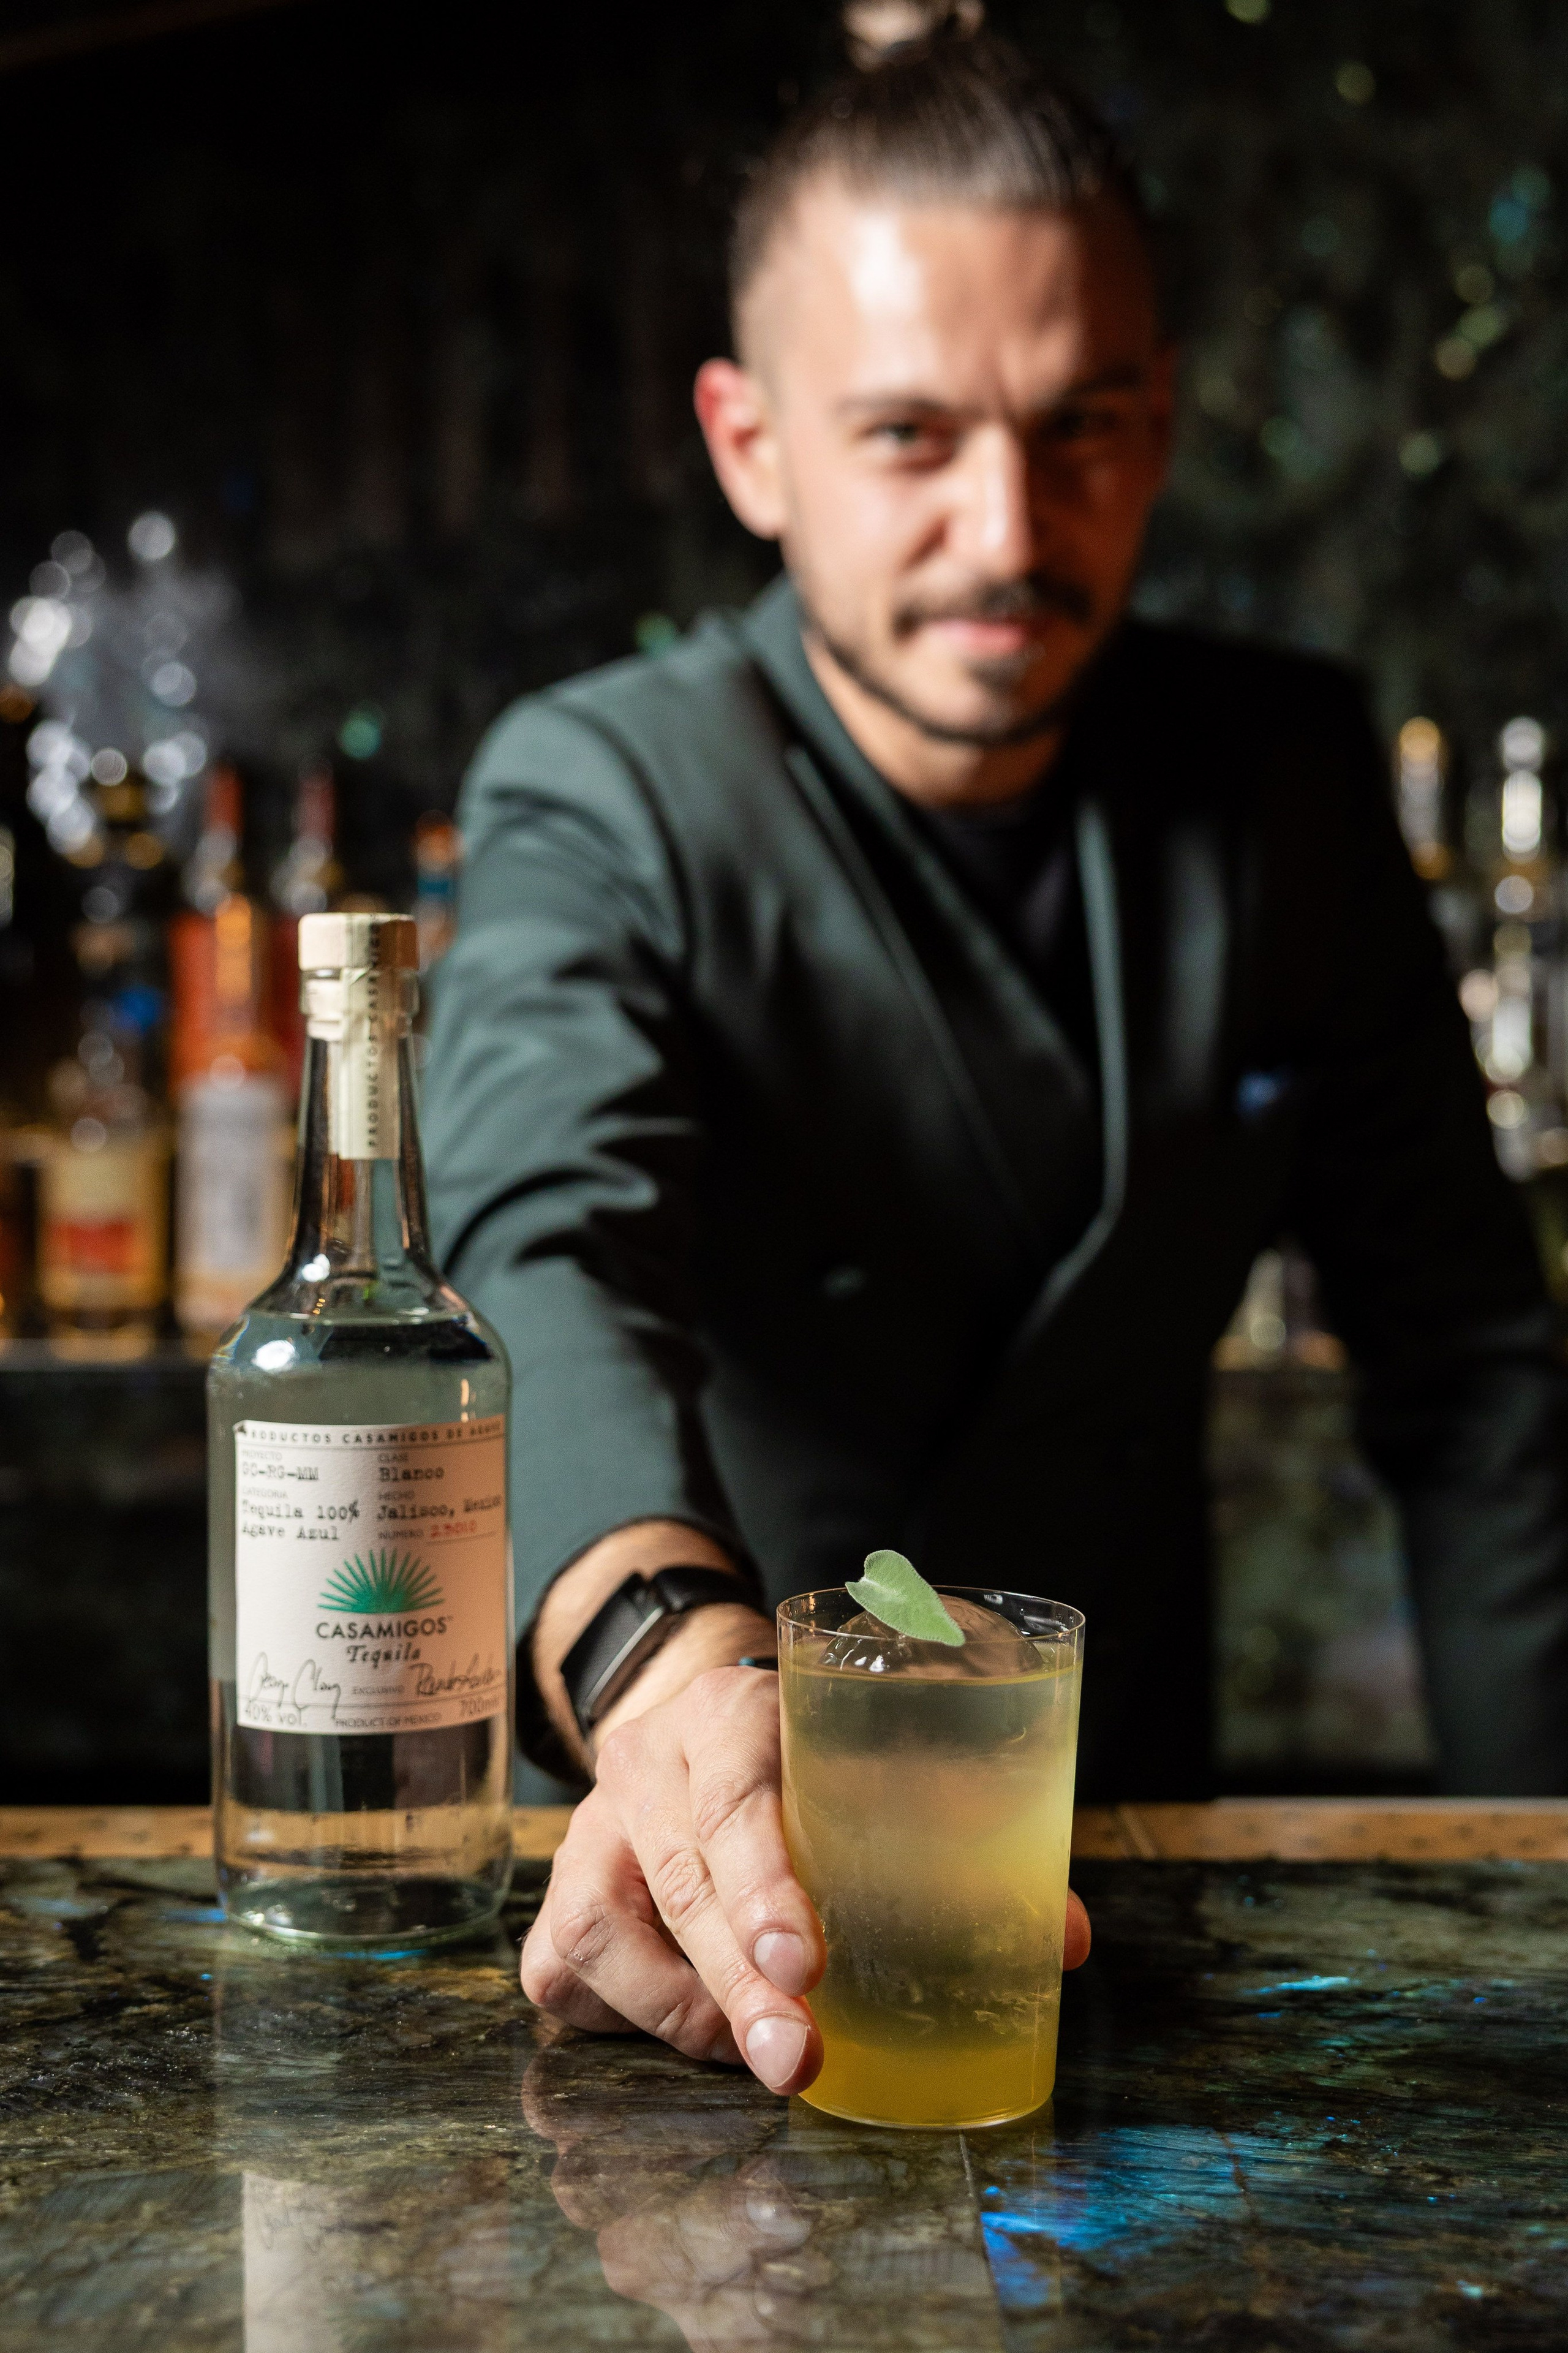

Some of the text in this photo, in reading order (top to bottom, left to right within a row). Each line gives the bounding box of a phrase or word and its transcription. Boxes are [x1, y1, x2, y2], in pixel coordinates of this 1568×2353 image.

[342, 1430, 438, 1443] CASAMIGOS
[379, 1467, 445, 1482] Blanco
[242, 1499, 360, 1523] Tequila 100%
[242, 1522, 339, 1541] Agave Azul
[316, 1616, 447, 1639] CASAMIGOS
[346, 1642, 421, 1669] Tequila
